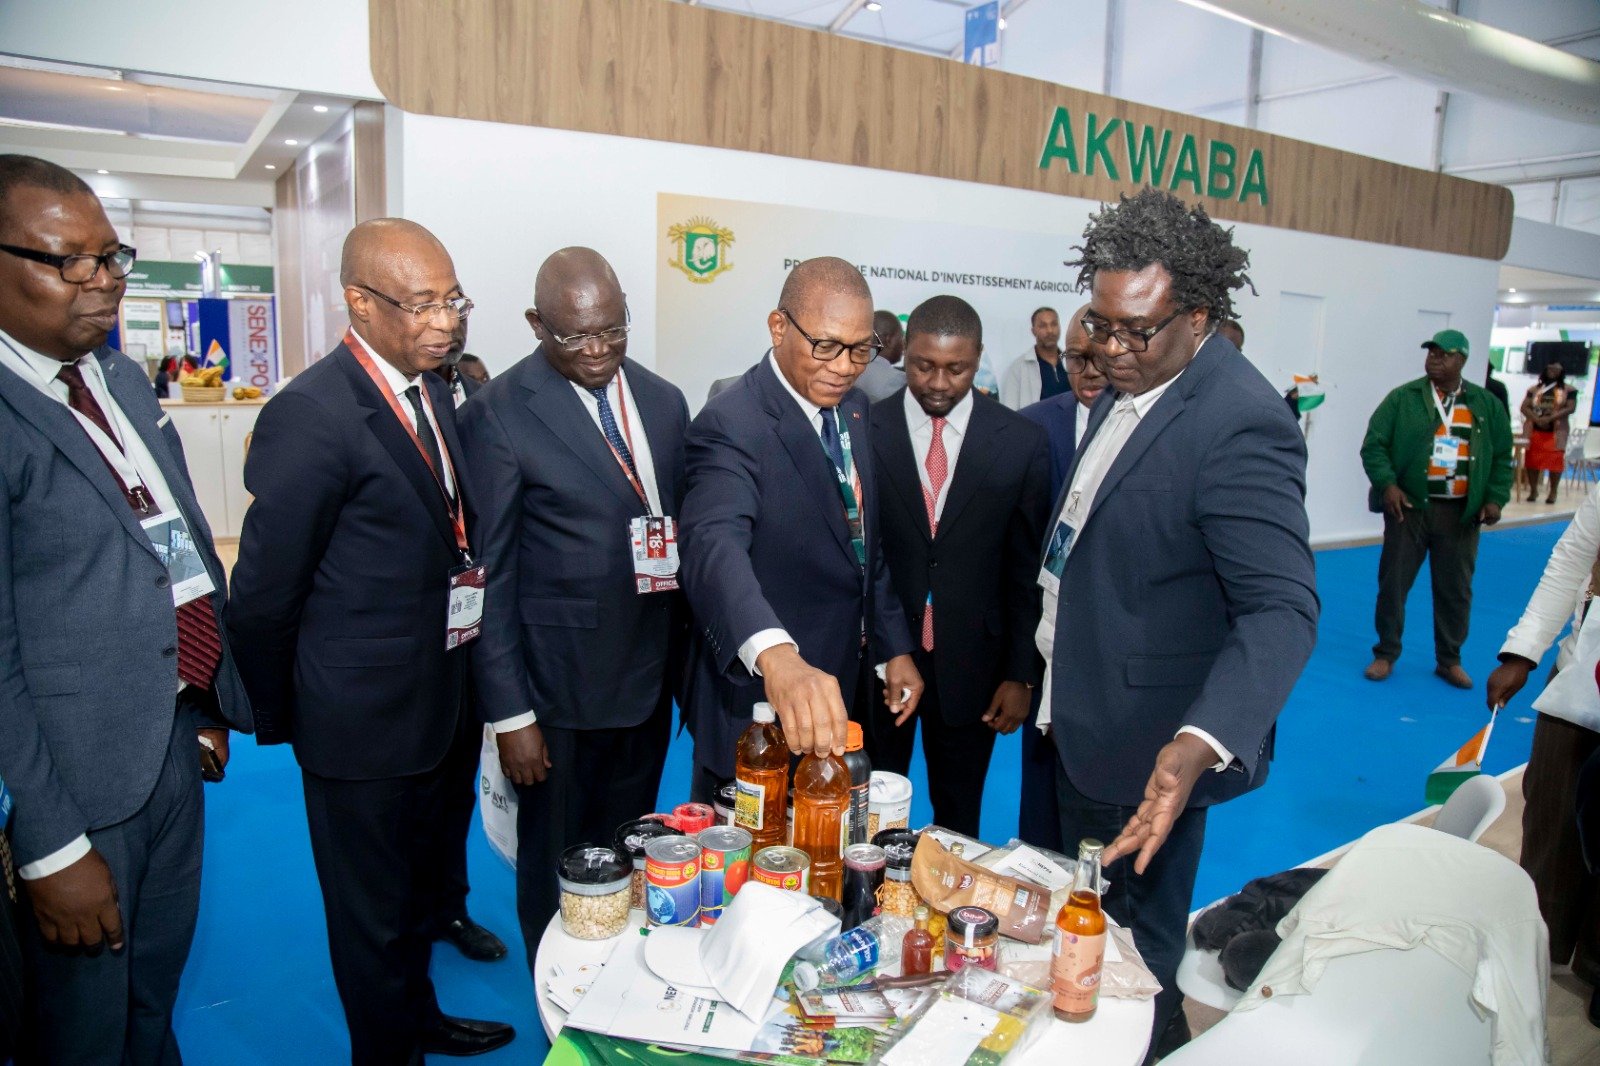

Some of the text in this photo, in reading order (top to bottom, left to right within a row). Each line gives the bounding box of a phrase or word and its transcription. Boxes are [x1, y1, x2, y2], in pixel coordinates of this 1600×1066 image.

[1039, 106, 1269, 206] AKWABA
[870, 266, 929, 281] NATIONAL
[931, 271, 1032, 290] D'INVESTISSEMENT
[248, 305, 269, 388] SENEXPO
[648, 532, 664, 549] 18
[655, 579, 678, 588] OFFICIE
[663, 985, 678, 1001] NEP
